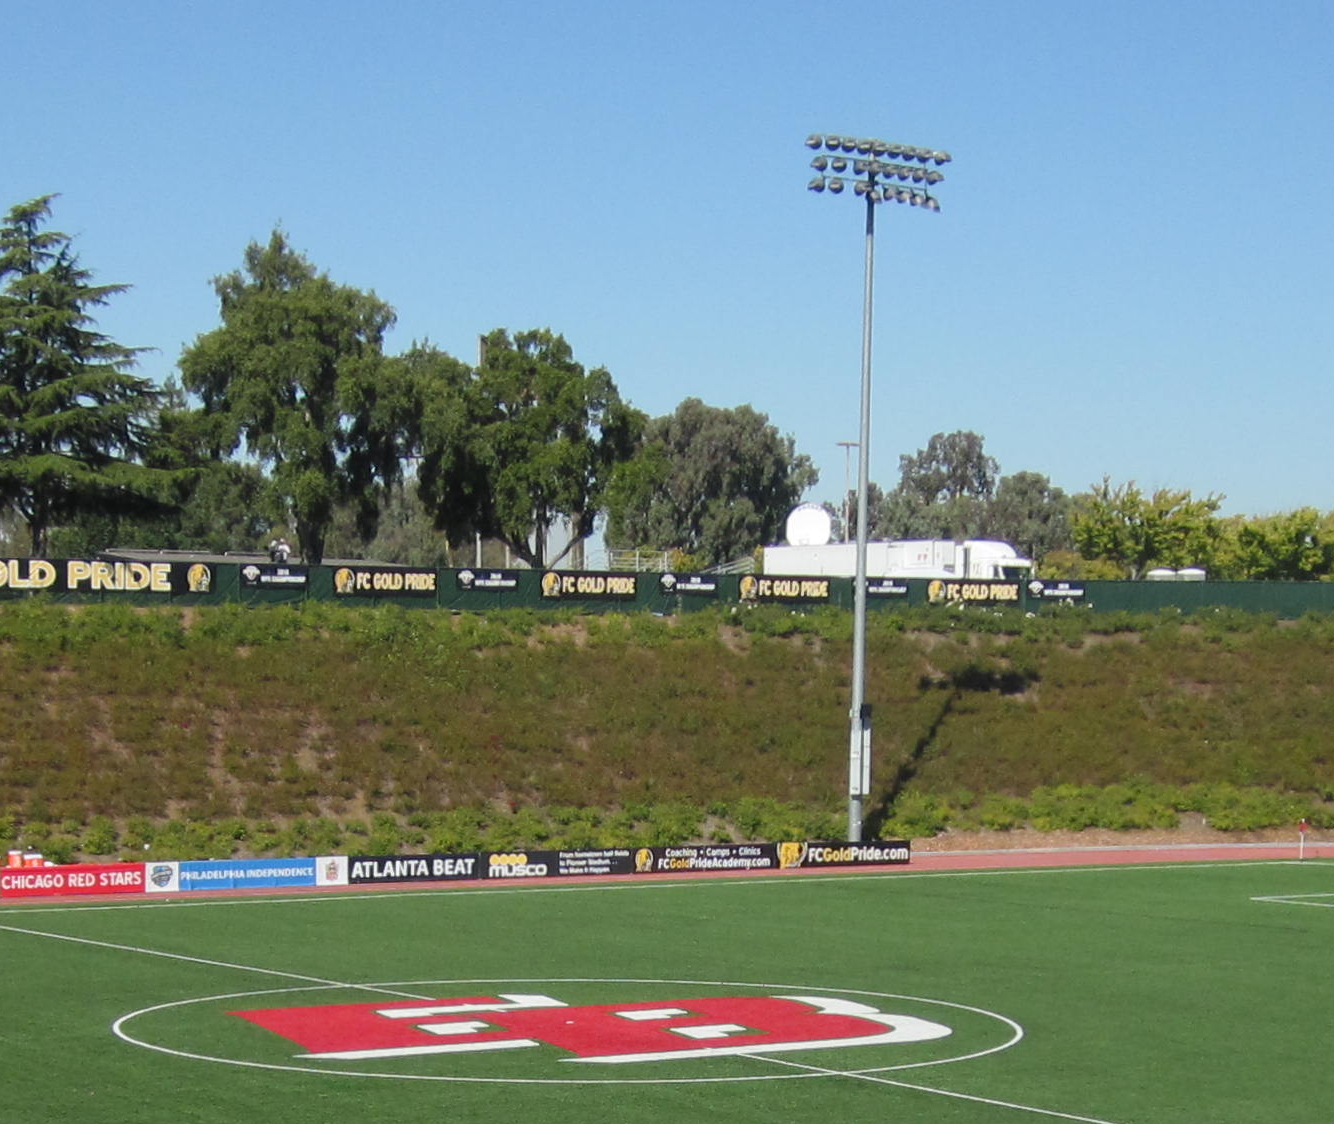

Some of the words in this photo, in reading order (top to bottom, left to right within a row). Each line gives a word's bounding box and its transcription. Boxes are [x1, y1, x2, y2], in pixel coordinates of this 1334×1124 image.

[67, 560, 172, 592] PRIDE
[357, 572, 371, 589] FC
[373, 573, 403, 590] GOLD
[405, 573, 436, 590] PRIDE
[562, 576, 575, 592] FC
[577, 577, 604, 593] GOLD
[606, 577, 635, 594] PRIDE
[759, 580, 771, 596] FC
[773, 580, 799, 597] GOLD
[801, 581, 828, 597] PRIDE
[947, 584, 960, 599] FC
[962, 585, 988, 599] GOLD
[989, 585, 1018, 600] PRIDE
[665, 848, 697, 858] Coaching
[706, 847, 730, 858] Camps
[739, 846, 761, 856] Clinics
[808, 846, 909, 863] FCGoldPride.com
[181, 870, 245, 881] PHILADELPHIA
[247, 867, 314, 878] INDEPENDENCE
[352, 861, 429, 878] ATLANTA
[433, 858, 475, 876] BEAT
[1, 875, 64, 890] CHICAGO
[68, 873, 95, 887] RED
[100, 871, 142, 886] STARS
